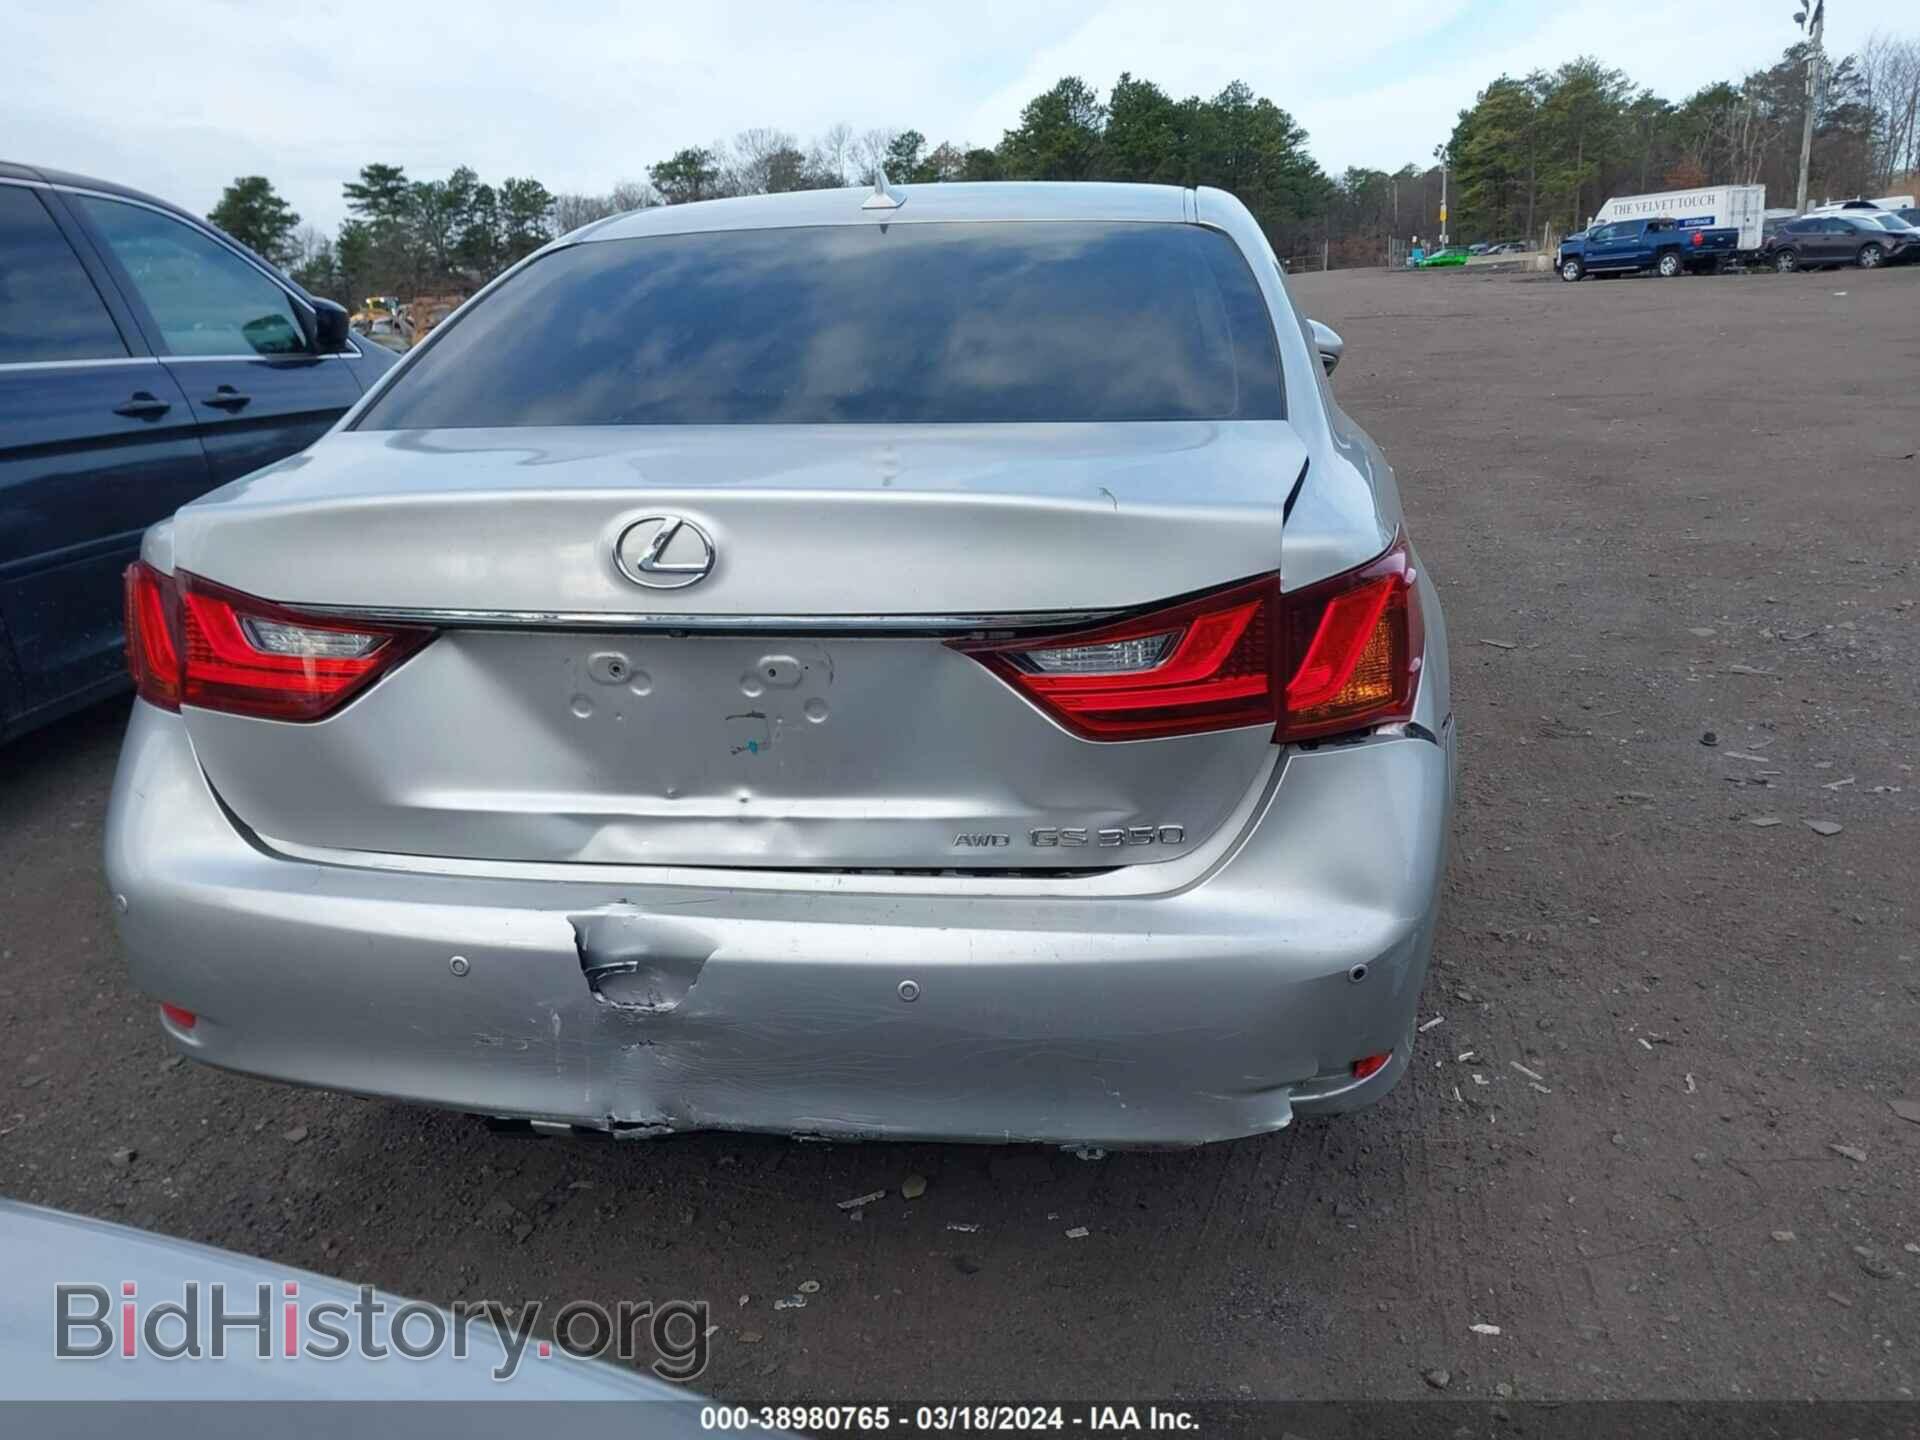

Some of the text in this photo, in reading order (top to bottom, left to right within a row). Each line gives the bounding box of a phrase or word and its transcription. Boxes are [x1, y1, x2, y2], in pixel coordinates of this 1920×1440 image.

[1613, 194, 1716, 216] THE VELVET TOUCH
[953, 824, 1185, 848] AWD GS 350
